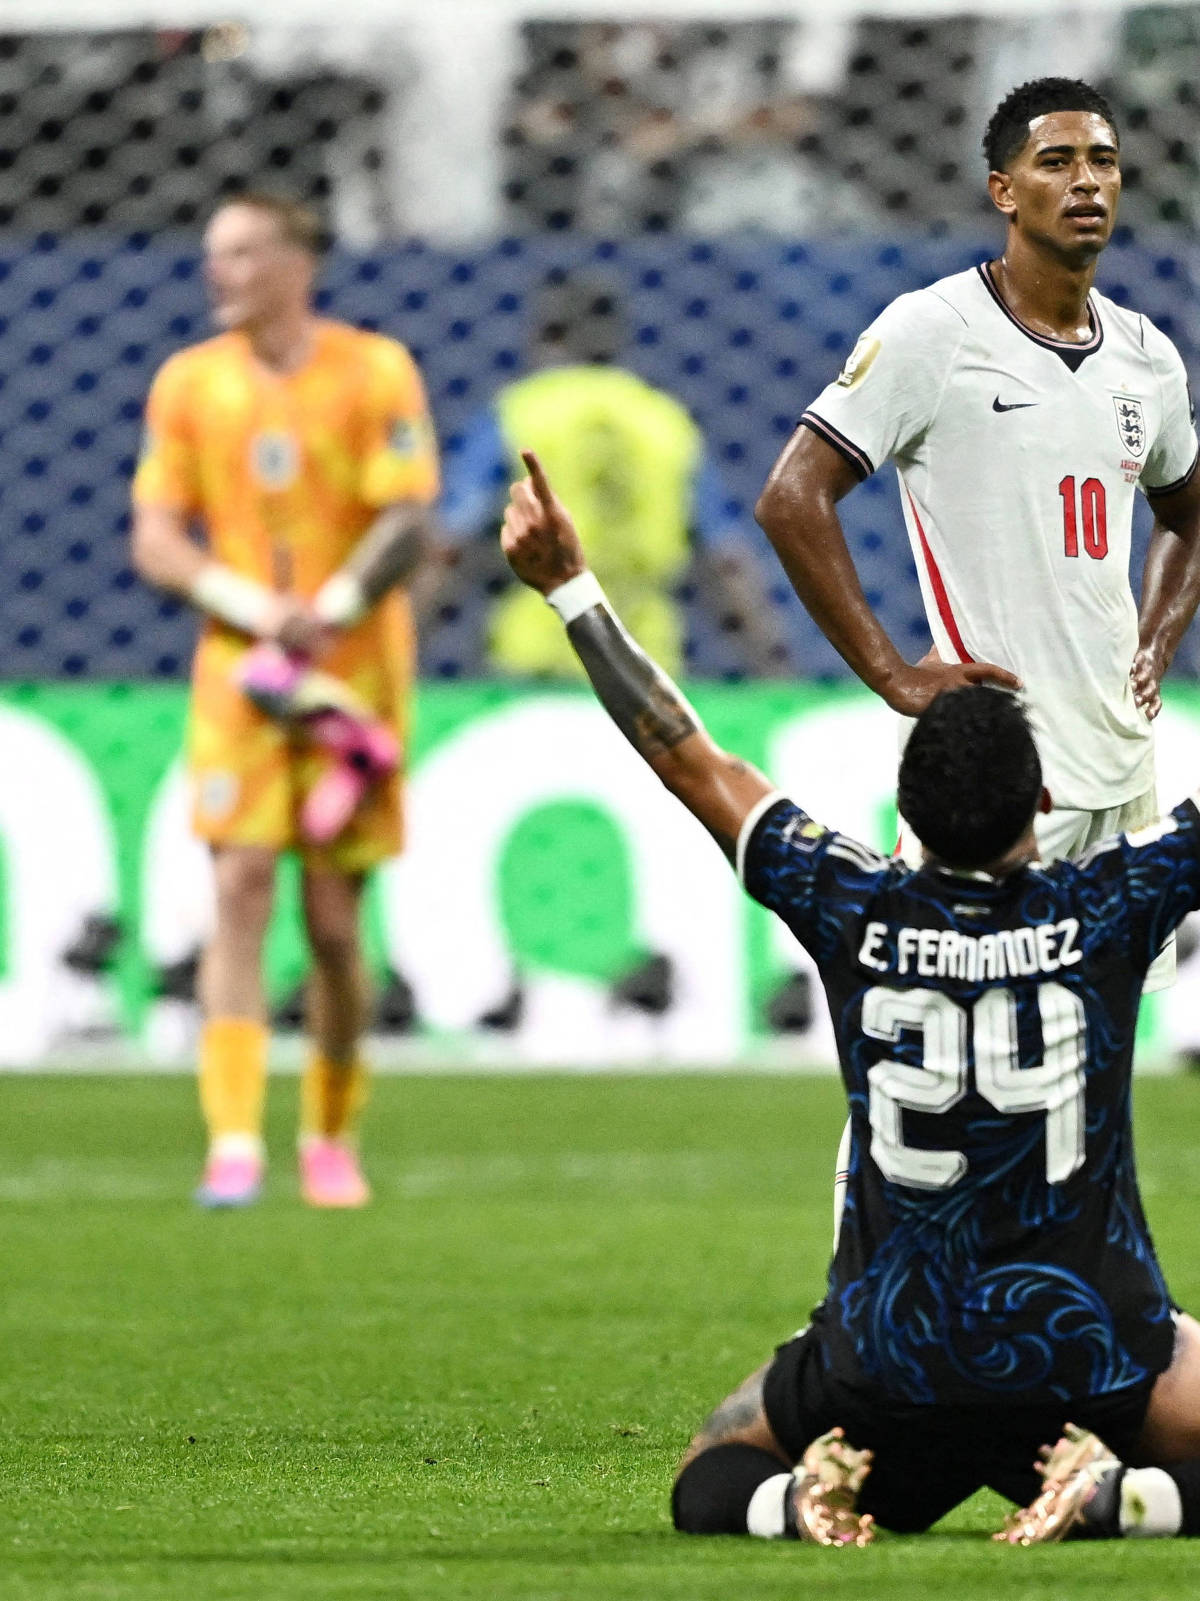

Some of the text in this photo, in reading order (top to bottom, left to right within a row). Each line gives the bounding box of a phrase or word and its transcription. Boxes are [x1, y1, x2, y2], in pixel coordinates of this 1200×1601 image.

[1058, 475, 1109, 560] 10
[857, 918, 1083, 982] E. FERNANDEZ
[861, 981, 1087, 1189] 24
